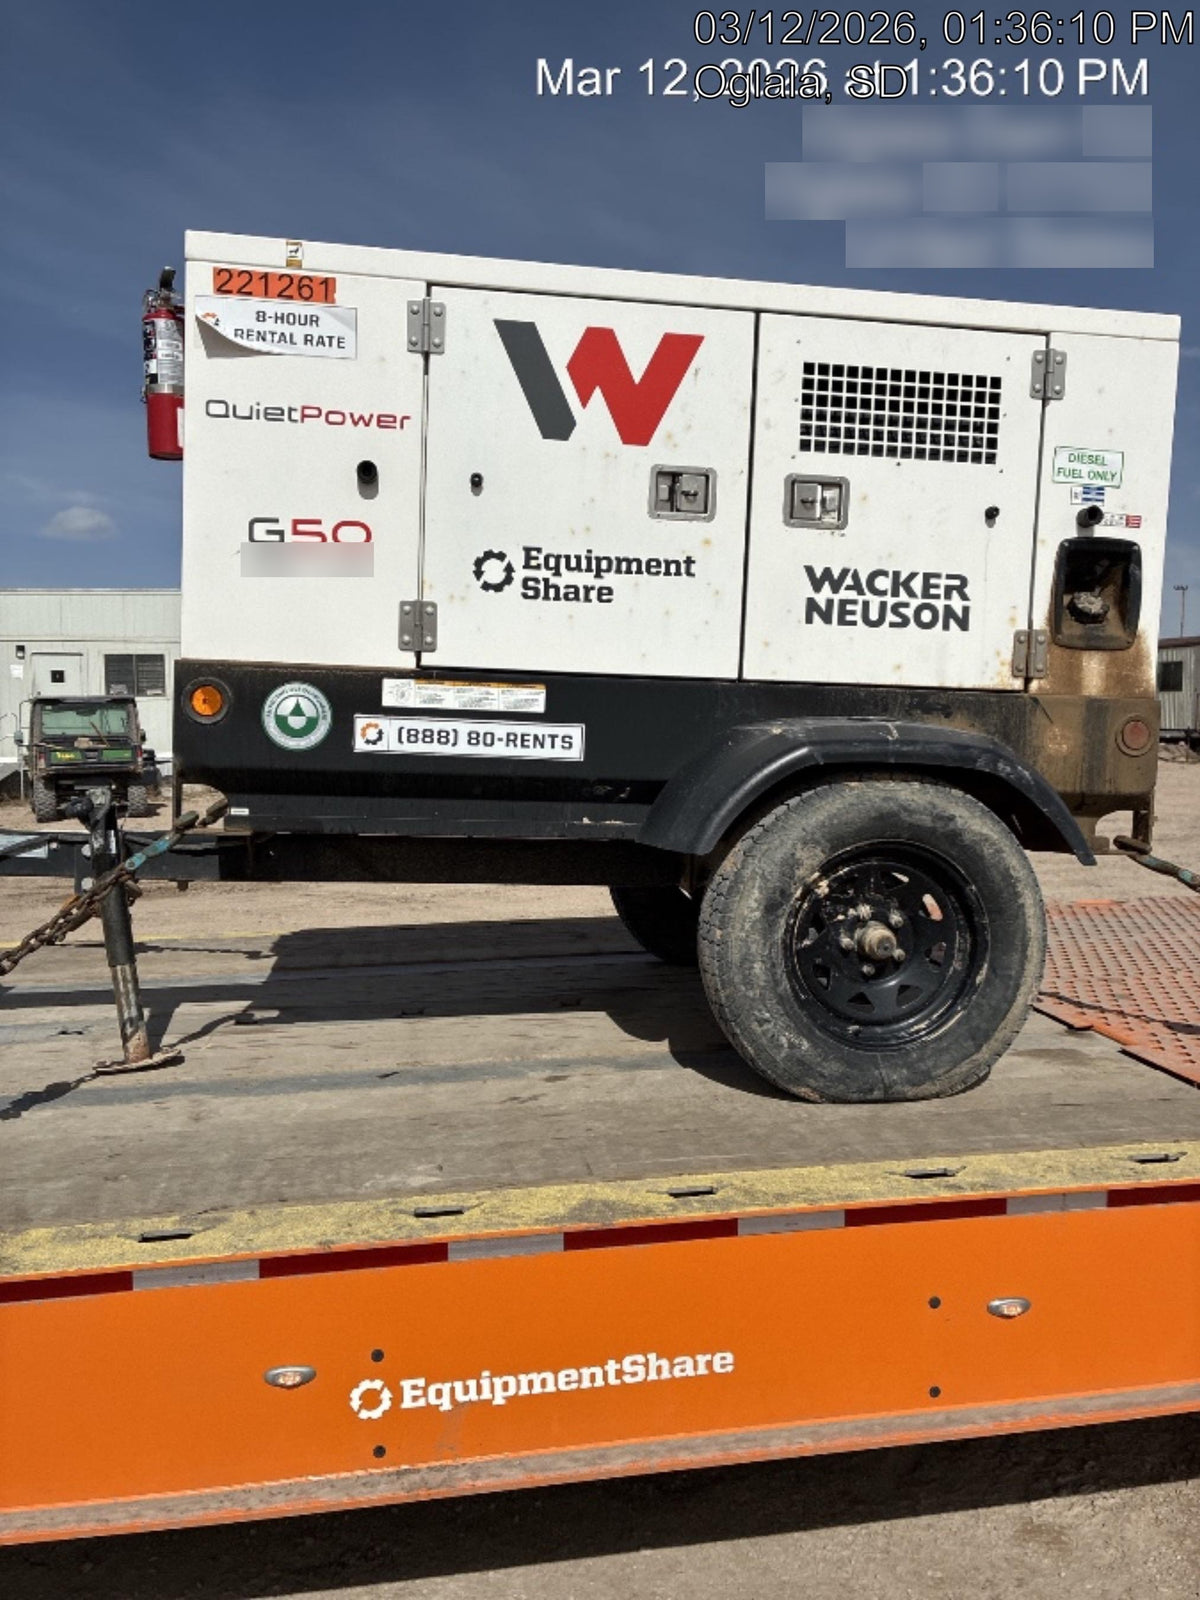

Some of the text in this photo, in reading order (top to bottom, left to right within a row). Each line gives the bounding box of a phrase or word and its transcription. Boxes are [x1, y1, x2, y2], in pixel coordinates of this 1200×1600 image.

[214, 268, 334, 302] 221261
[255, 310, 320, 328] 8-HOUR
[234, 327, 346, 349] RENTAL RATE
[205, 399, 411, 430] QuietPower
[1068, 453, 1108, 466] DIESEL
[1056, 467, 1118, 482] FUEL ONLY
[248, 516, 373, 543] G50
[522, 546, 696, 579] Equipment
[521, 576, 614, 603] Share
[803, 565, 971, 601] WACKER
[805, 597, 970, 632] NEUSON
[397, 727, 574, 751] (888) 80-RENTS
[400, 1351, 735, 1412] EquipmentShare
